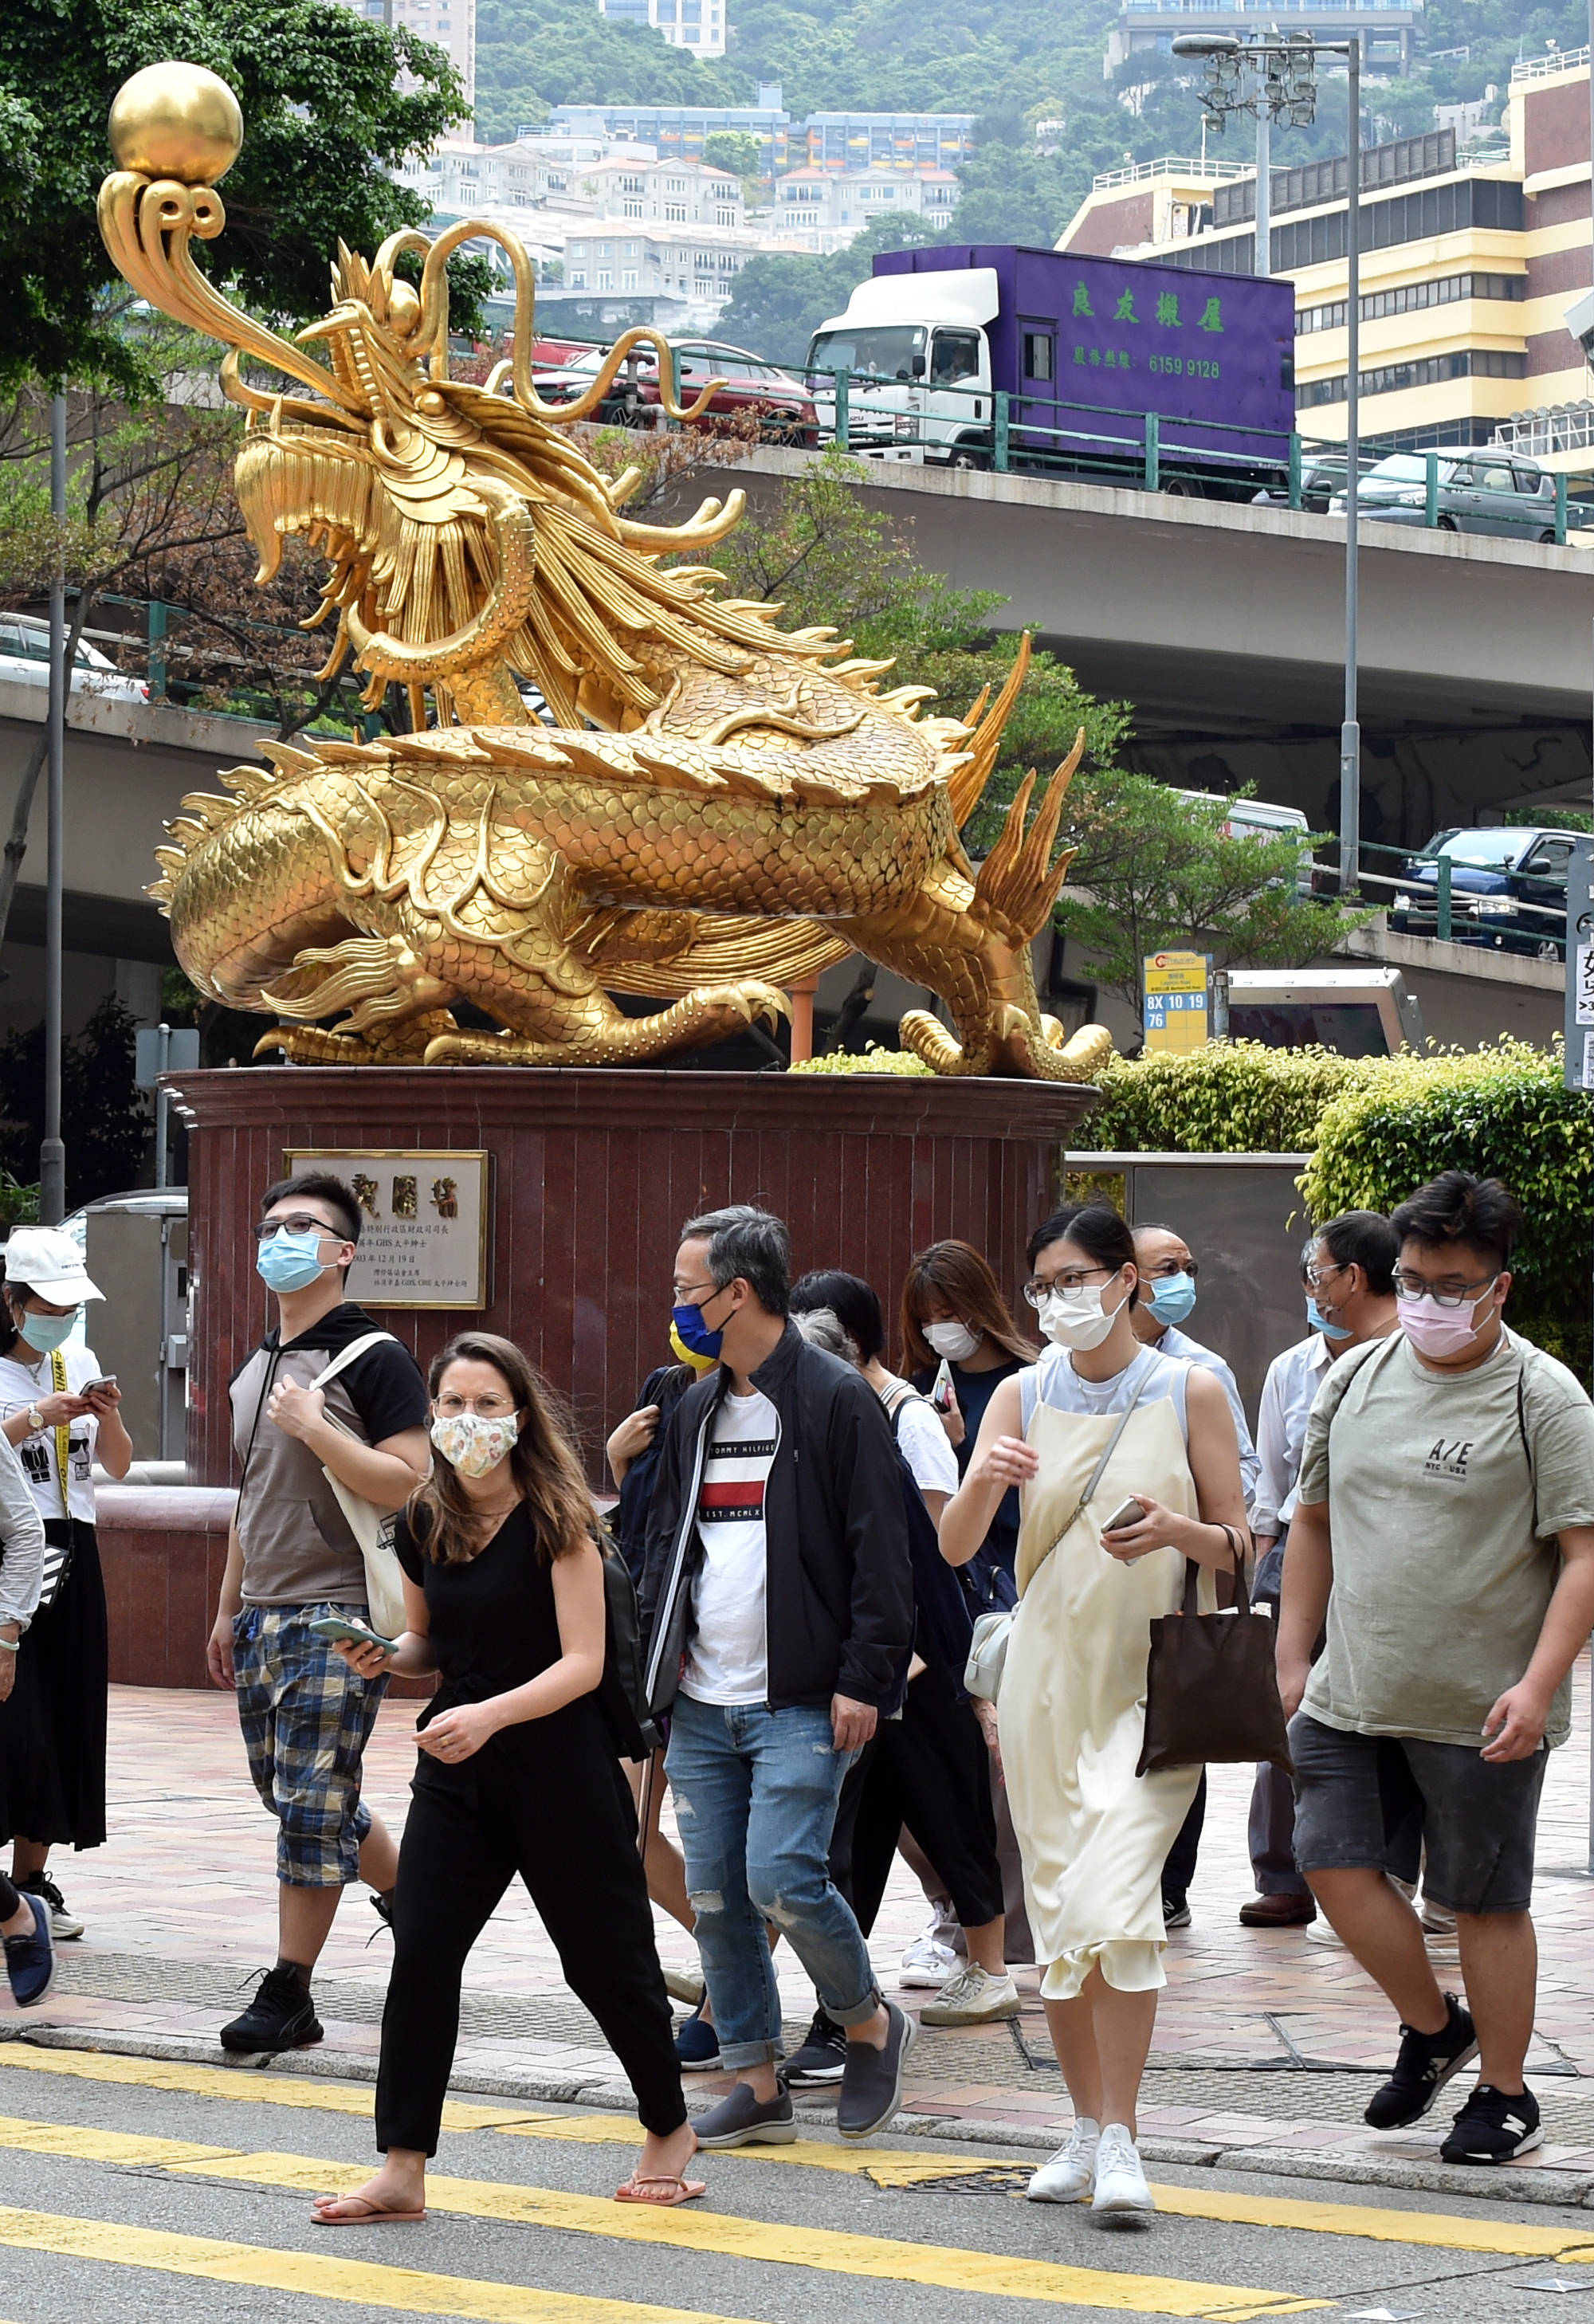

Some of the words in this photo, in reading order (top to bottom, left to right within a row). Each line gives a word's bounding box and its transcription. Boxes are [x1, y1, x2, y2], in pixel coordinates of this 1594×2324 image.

[1072, 280, 1225, 332] 良友搬屋
[1148, 355, 1183, 375] 6159
[1187, 359, 1219, 379] 9128
[1147, 995, 1164, 1010] 8X
[1168, 995, 1183, 1009] 10
[1189, 994, 1203, 1008] 19
[1148, 1013, 1163, 1027] 76
[742, 1445, 775, 1454] HILFIGE
[1428, 1439, 1474, 1466] A/E
[1425, 1462, 1441, 1470] NYC
[1449, 1466, 1466, 1475] USA
[730, 1509, 760, 1517] MCMLX
